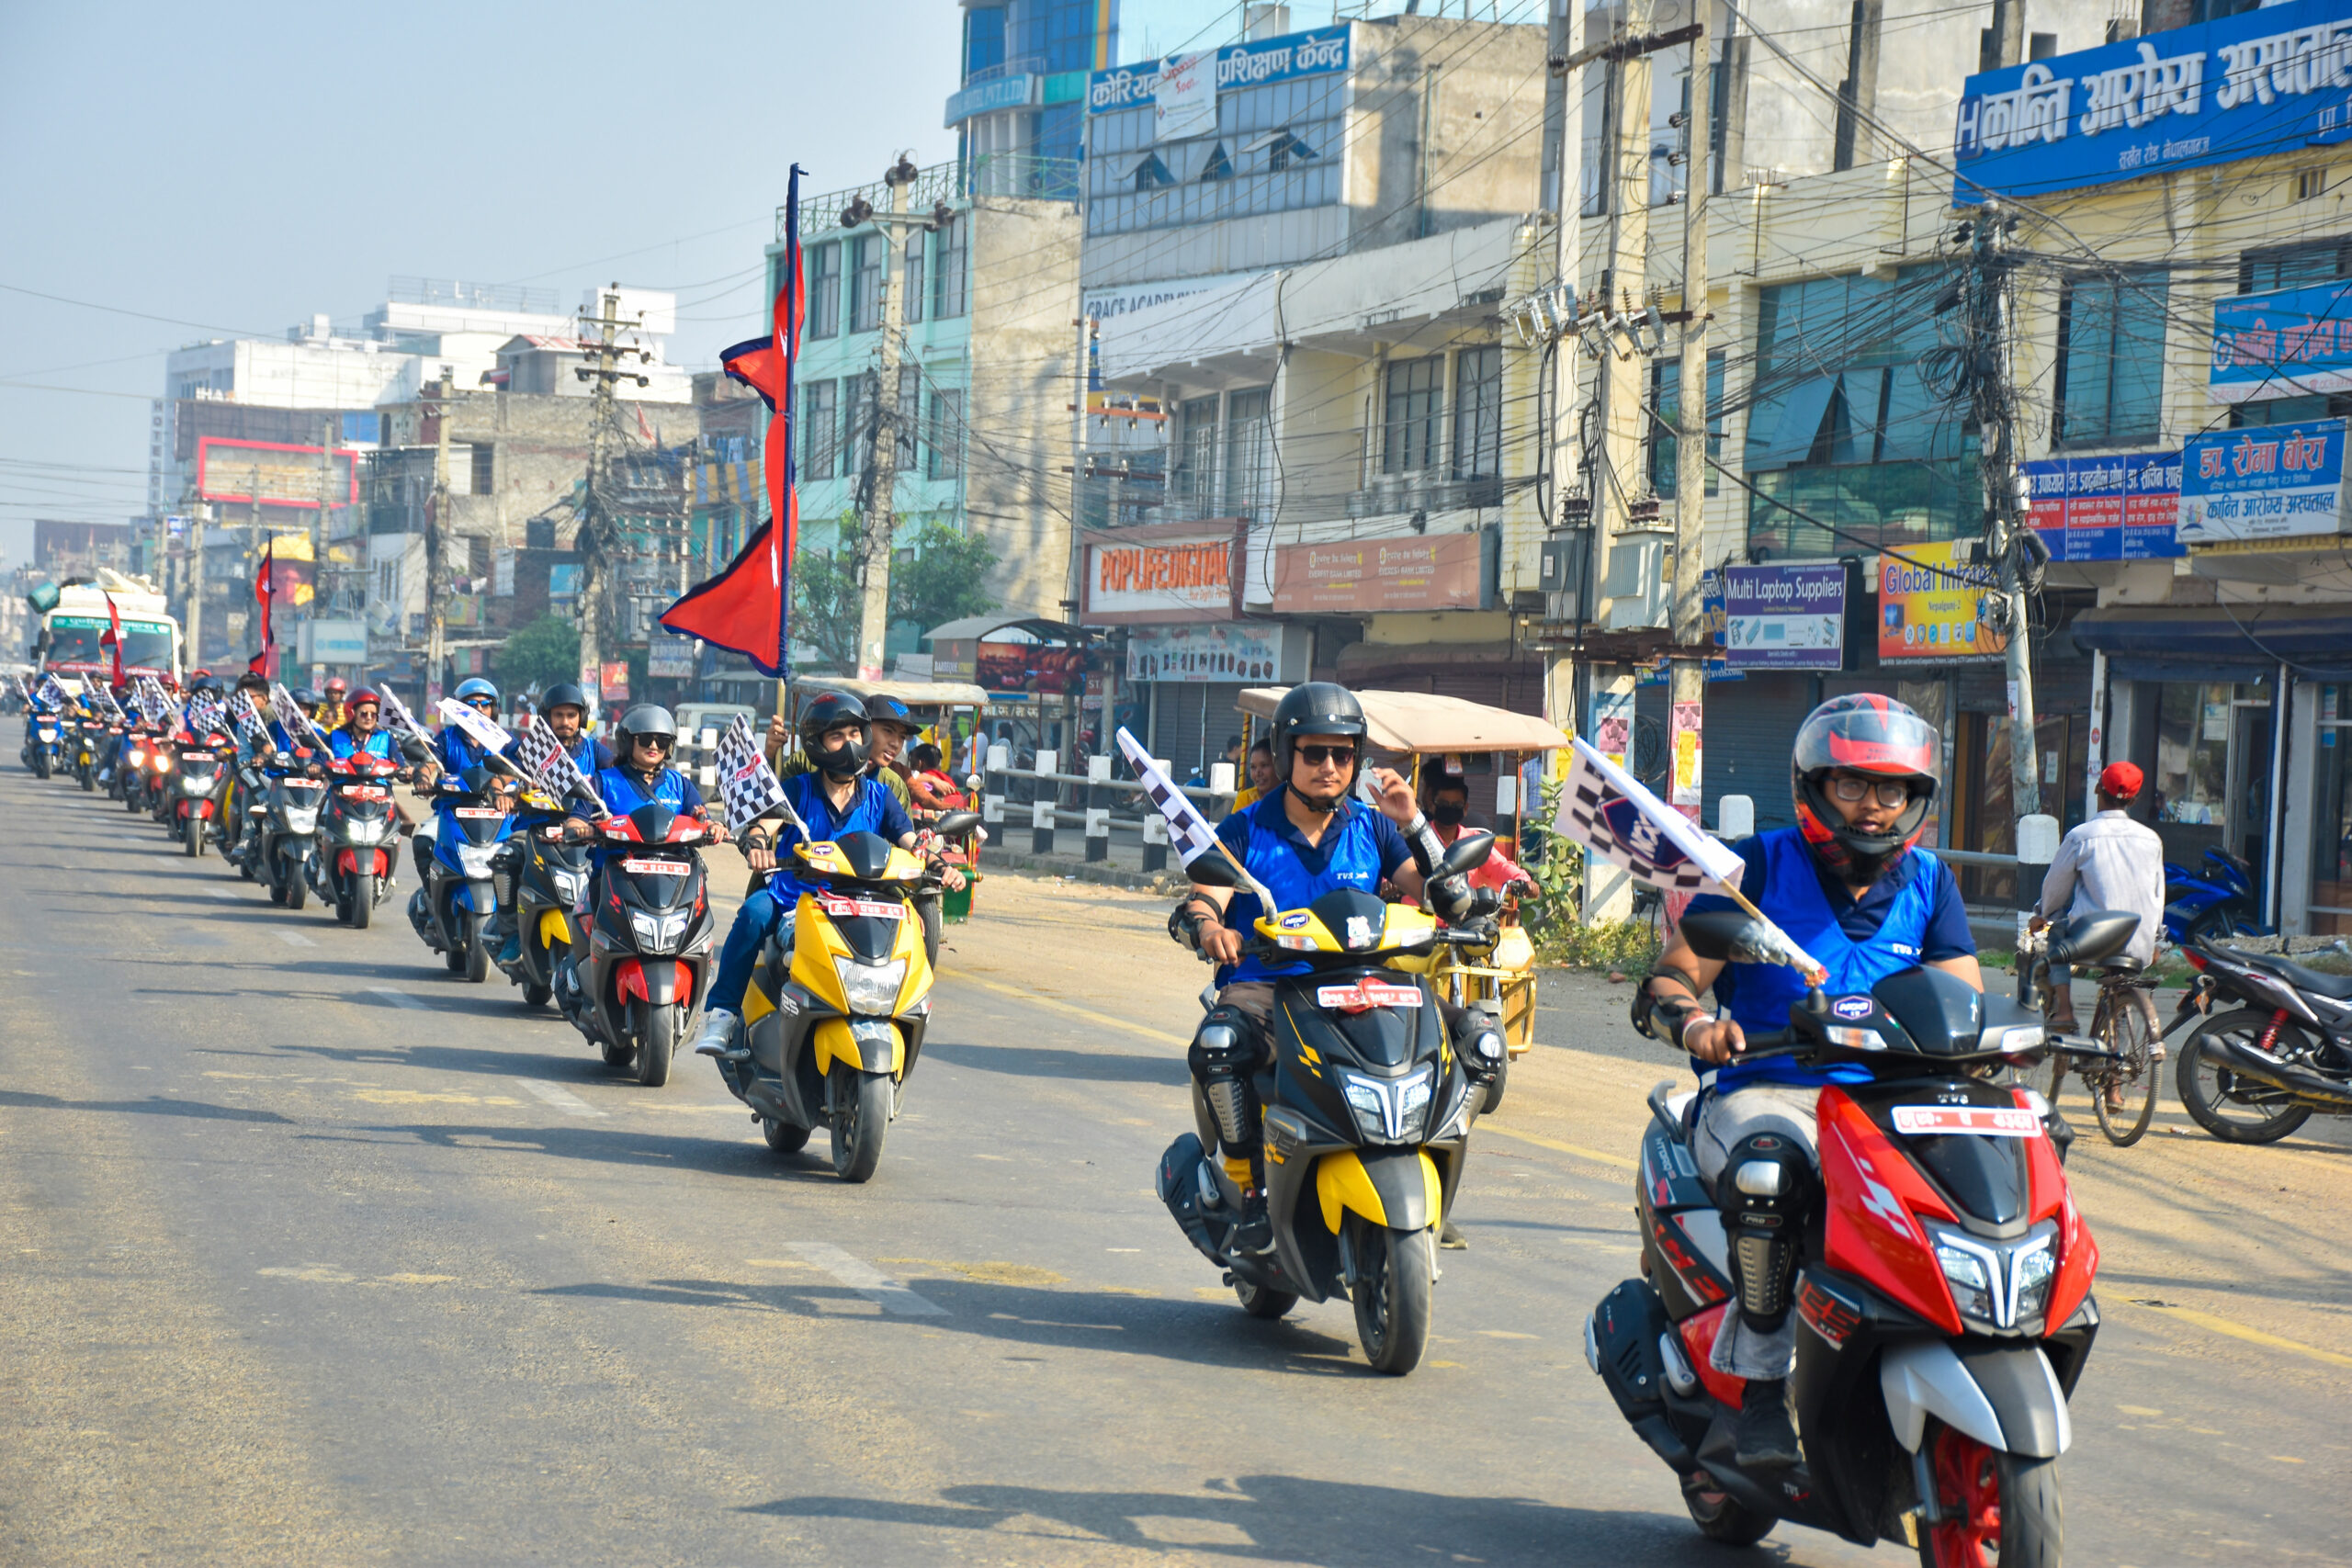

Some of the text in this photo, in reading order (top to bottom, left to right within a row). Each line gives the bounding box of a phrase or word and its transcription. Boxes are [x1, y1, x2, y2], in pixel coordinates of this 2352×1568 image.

[1217, 48, 1293, 87] प्रशिक्षण
[1296, 35, 1346, 69] केन्द्र
[1981, 63, 2075, 151] कान्ति
[2079, 42, 2207, 137] आरोग्य
[2199, 446, 2227, 479] डा.
[2233, 434, 2279, 477] रोमा
[2208, 494, 2240, 519] कान्ति
[2243, 491, 2283, 517] आरोग्य
[2286, 491, 2336, 514] अस्पताल
[1727, 575, 1843, 604] Multi Laptop Suppliers
[1885, 561, 1936, 595] Global
[1337, 872, 1353, 880] TVS
[1893, 942, 1913, 955] TVS
